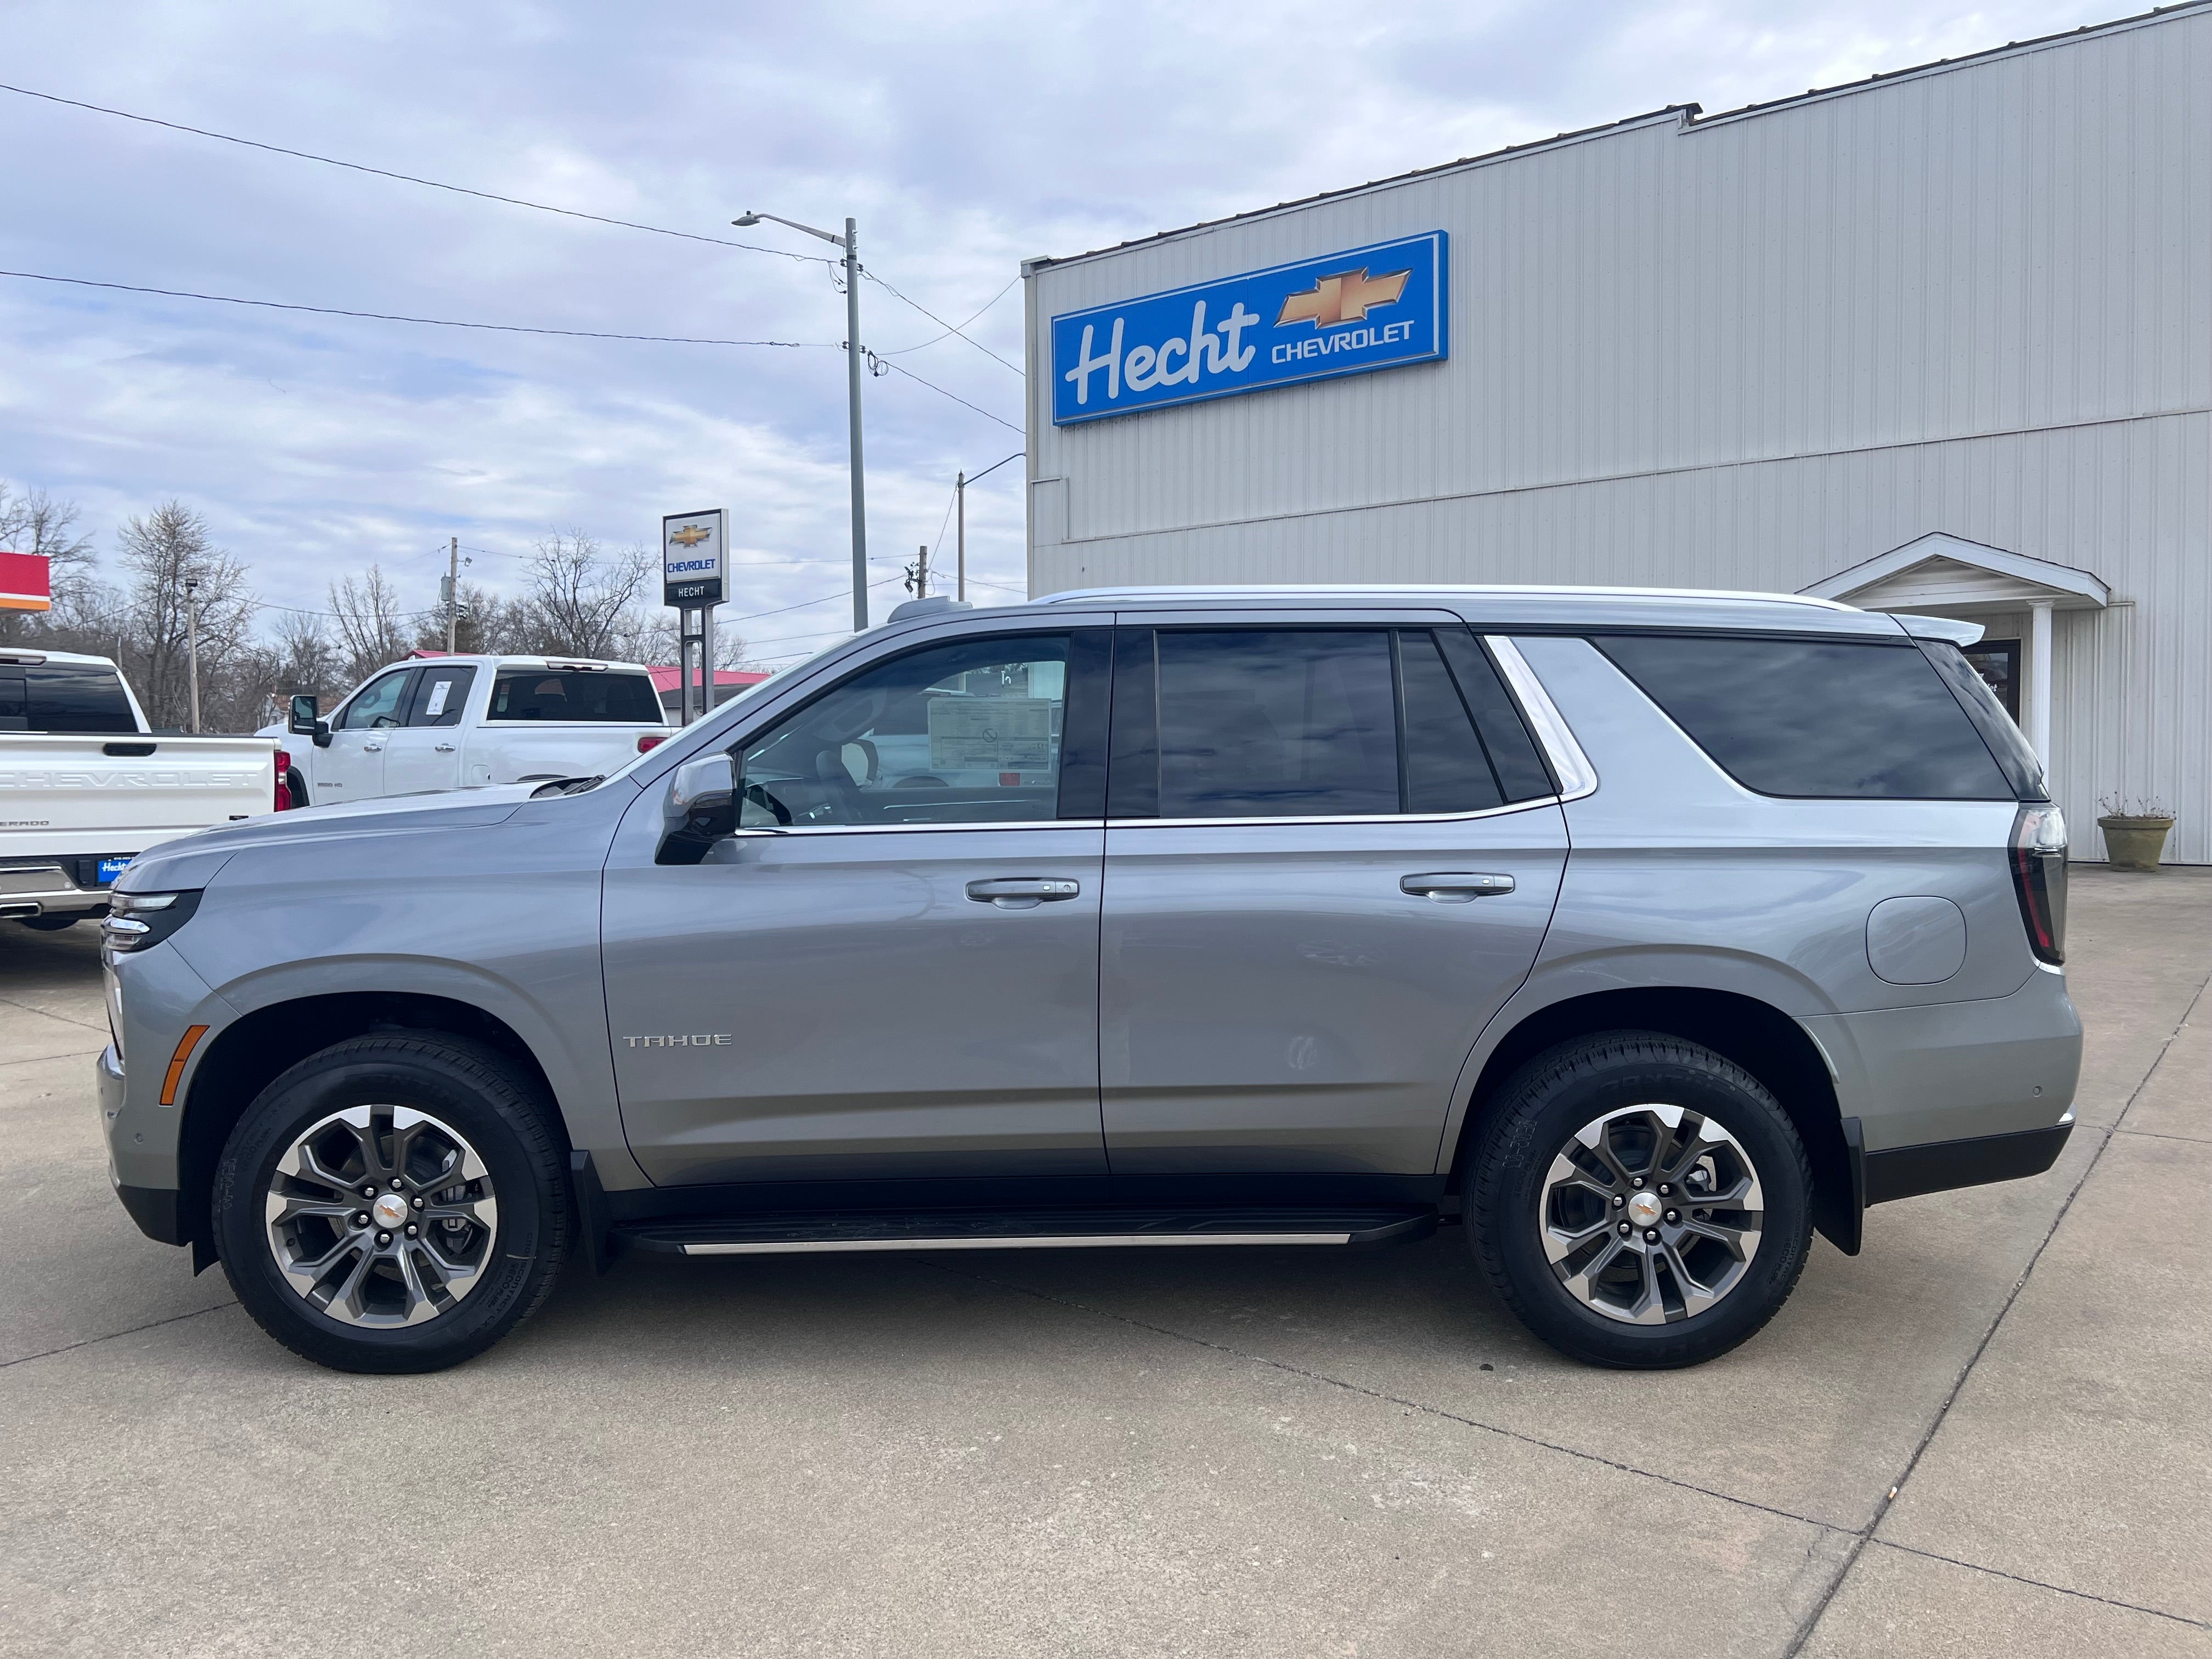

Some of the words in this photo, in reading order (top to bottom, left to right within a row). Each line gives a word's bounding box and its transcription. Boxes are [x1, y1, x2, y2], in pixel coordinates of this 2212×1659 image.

[1272, 320, 1415, 364] CHEVROLET
[1065, 300, 1260, 405] Hecht
[667, 558, 715, 573] CHEVROLET
[678, 585, 704, 597] HECHT
[623, 1034, 733, 1048] TAHOE
